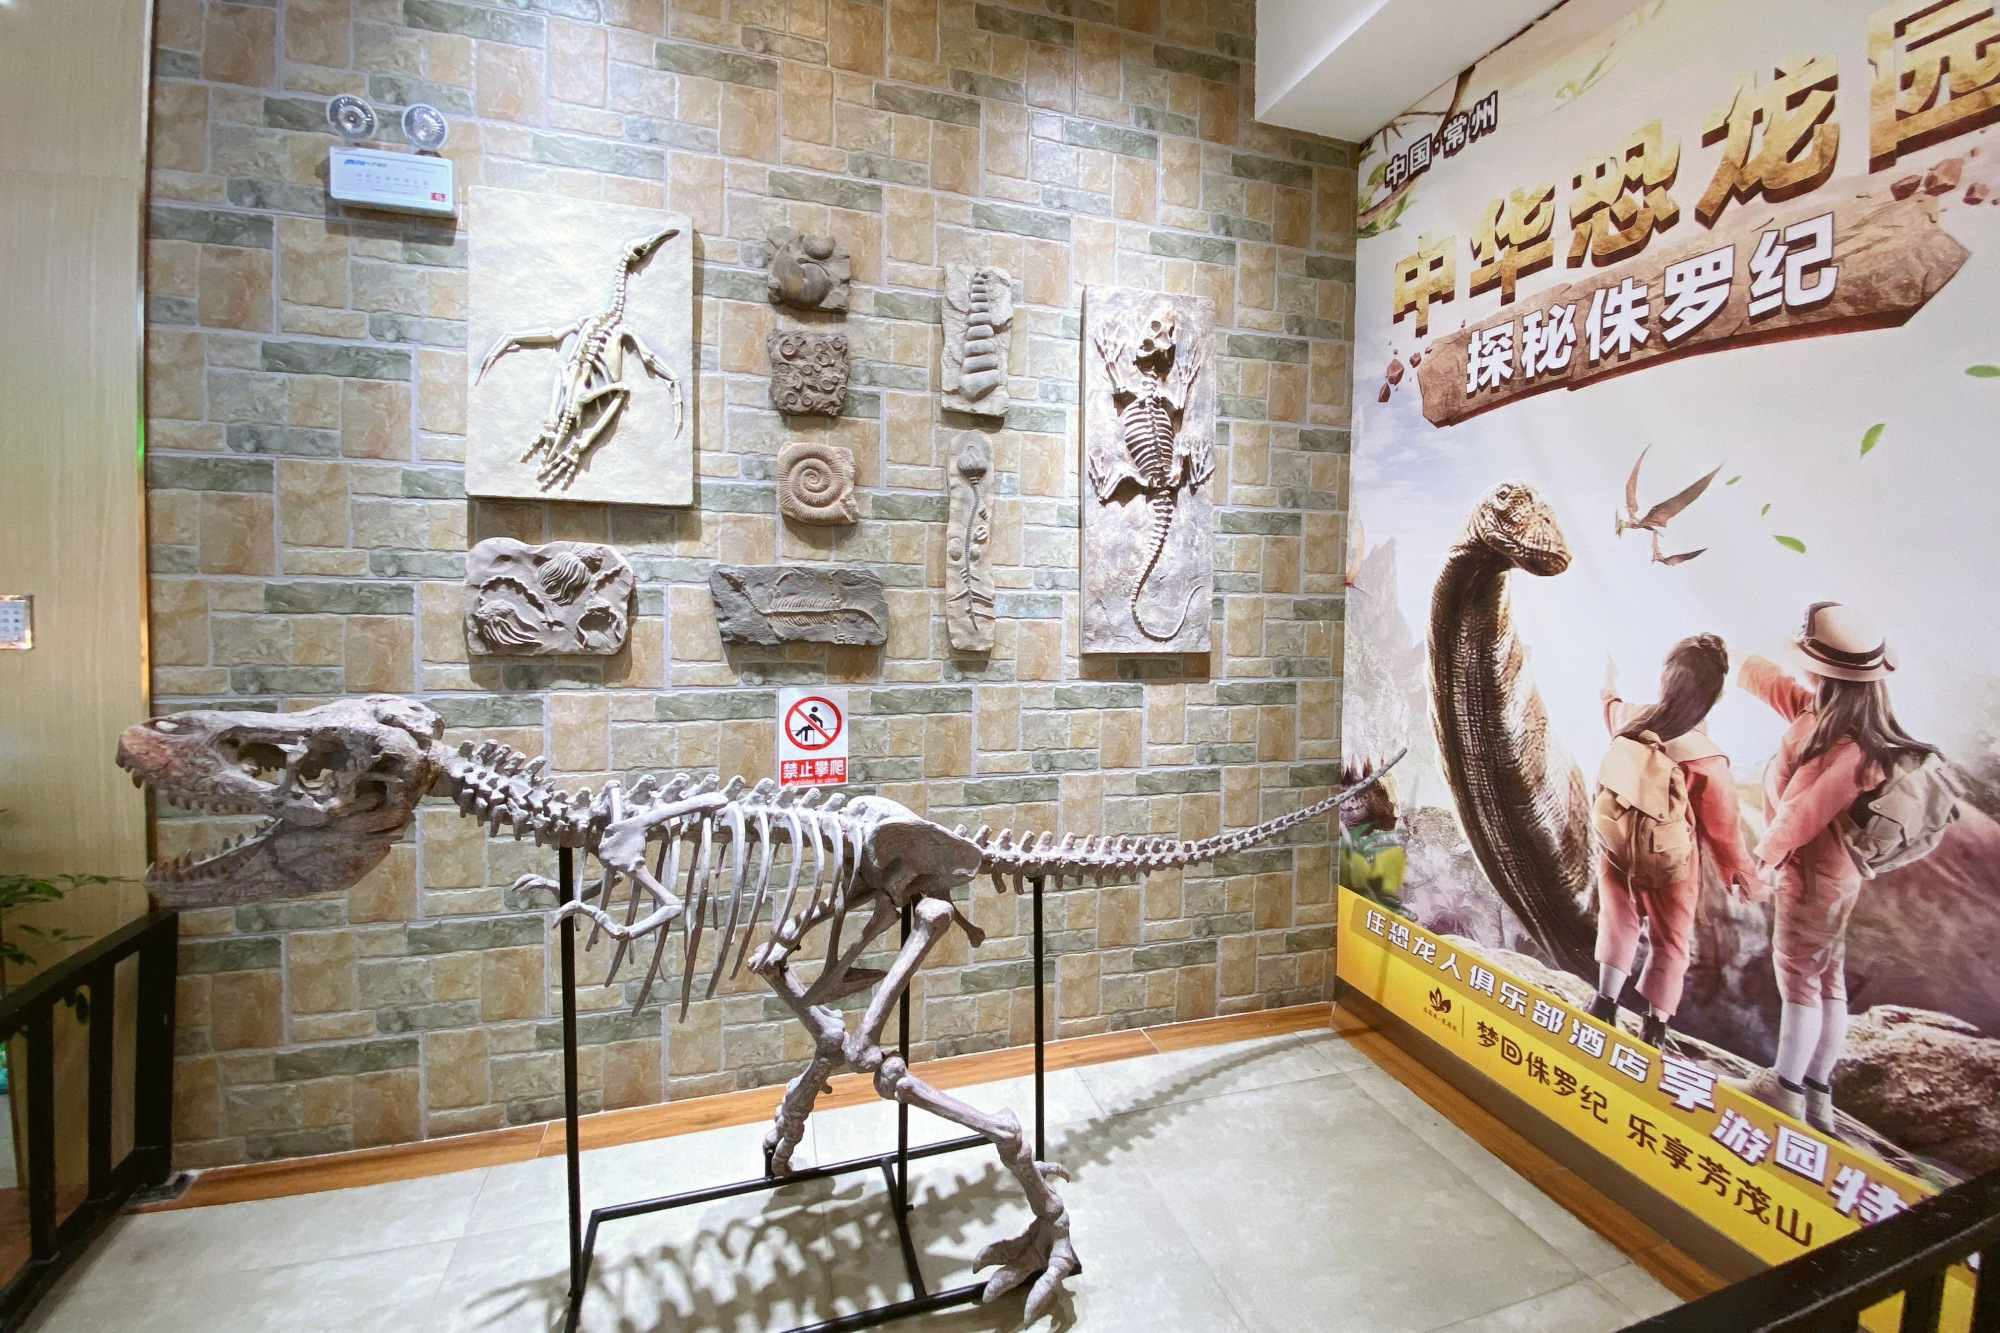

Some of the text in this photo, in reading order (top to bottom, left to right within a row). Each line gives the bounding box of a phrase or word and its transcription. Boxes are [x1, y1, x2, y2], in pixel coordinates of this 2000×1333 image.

[1385, 92, 1498, 189] 中国·常州
[1393, 0, 2000, 335] 中华恐龙园
[1466, 212, 1840, 396] 探秘侏罗纪
[783, 759, 844, 779] 禁止攀爬
[1476, 1021, 1813, 1247] 梦回侏罗纪 乐享芳茂山
